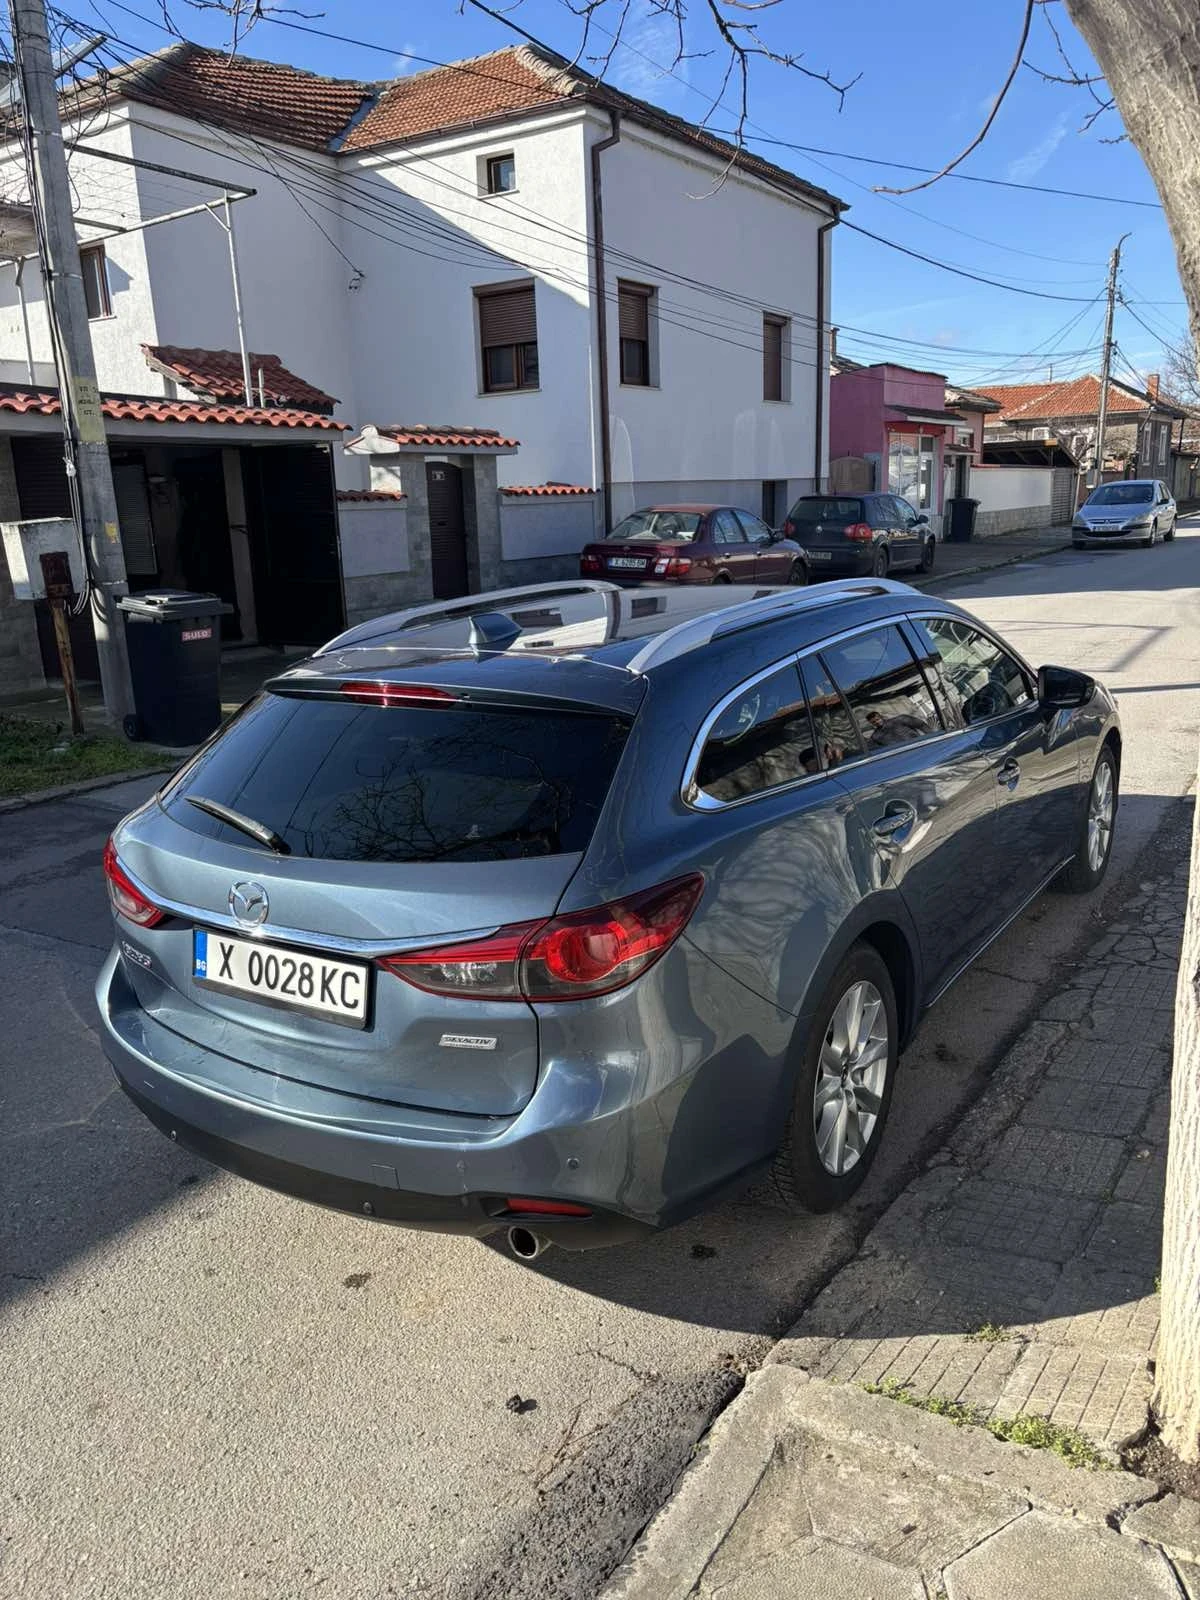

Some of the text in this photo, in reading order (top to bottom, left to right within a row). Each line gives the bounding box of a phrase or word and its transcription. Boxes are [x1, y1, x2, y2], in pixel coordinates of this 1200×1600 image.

[196, 958, 206, 970] BG
[219, 942, 360, 1009] X 0028 KC
